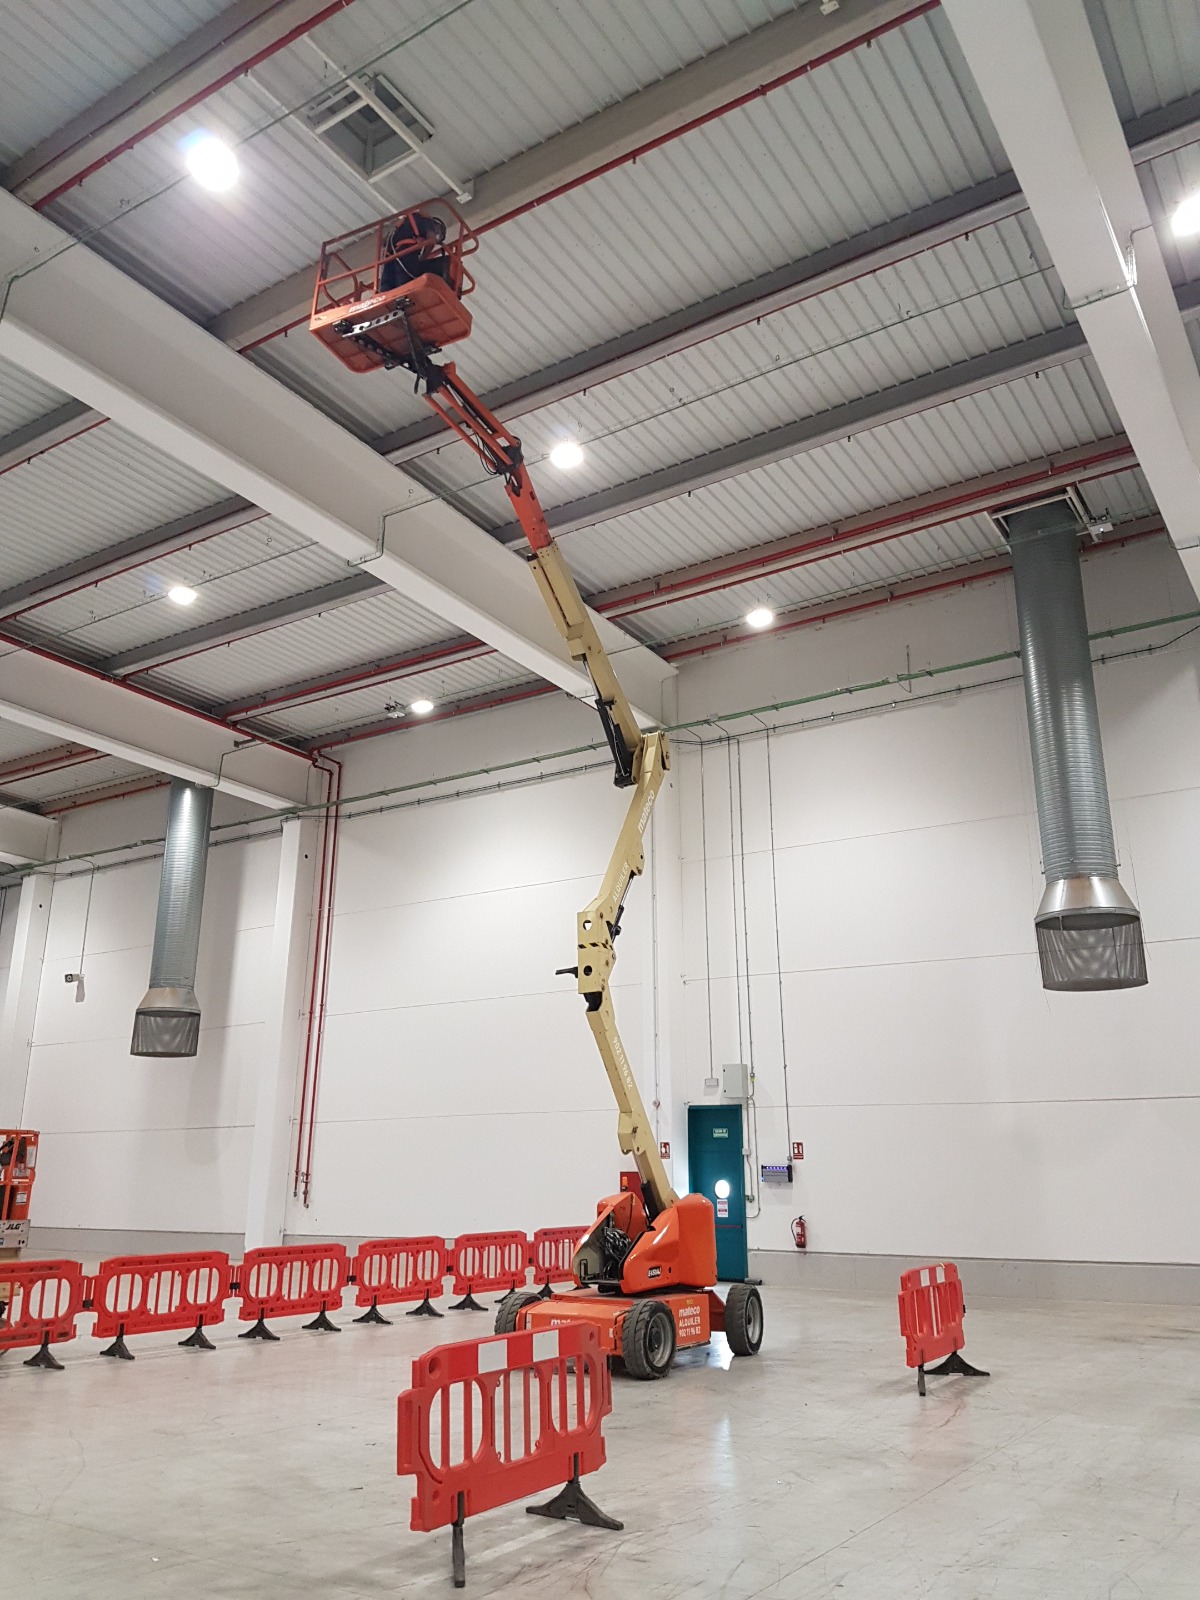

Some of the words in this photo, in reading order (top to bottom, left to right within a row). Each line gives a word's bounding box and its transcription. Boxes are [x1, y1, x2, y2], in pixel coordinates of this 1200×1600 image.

[638, 790, 654, 833] mateco
[612, 862, 630, 904] ALQUILER
[613, 1037, 621, 1055] 902
[679, 1306, 701, 1318] mateco
[679, 1316, 701, 1328] ALQUILER
[679, 1328, 687, 1338] 902
